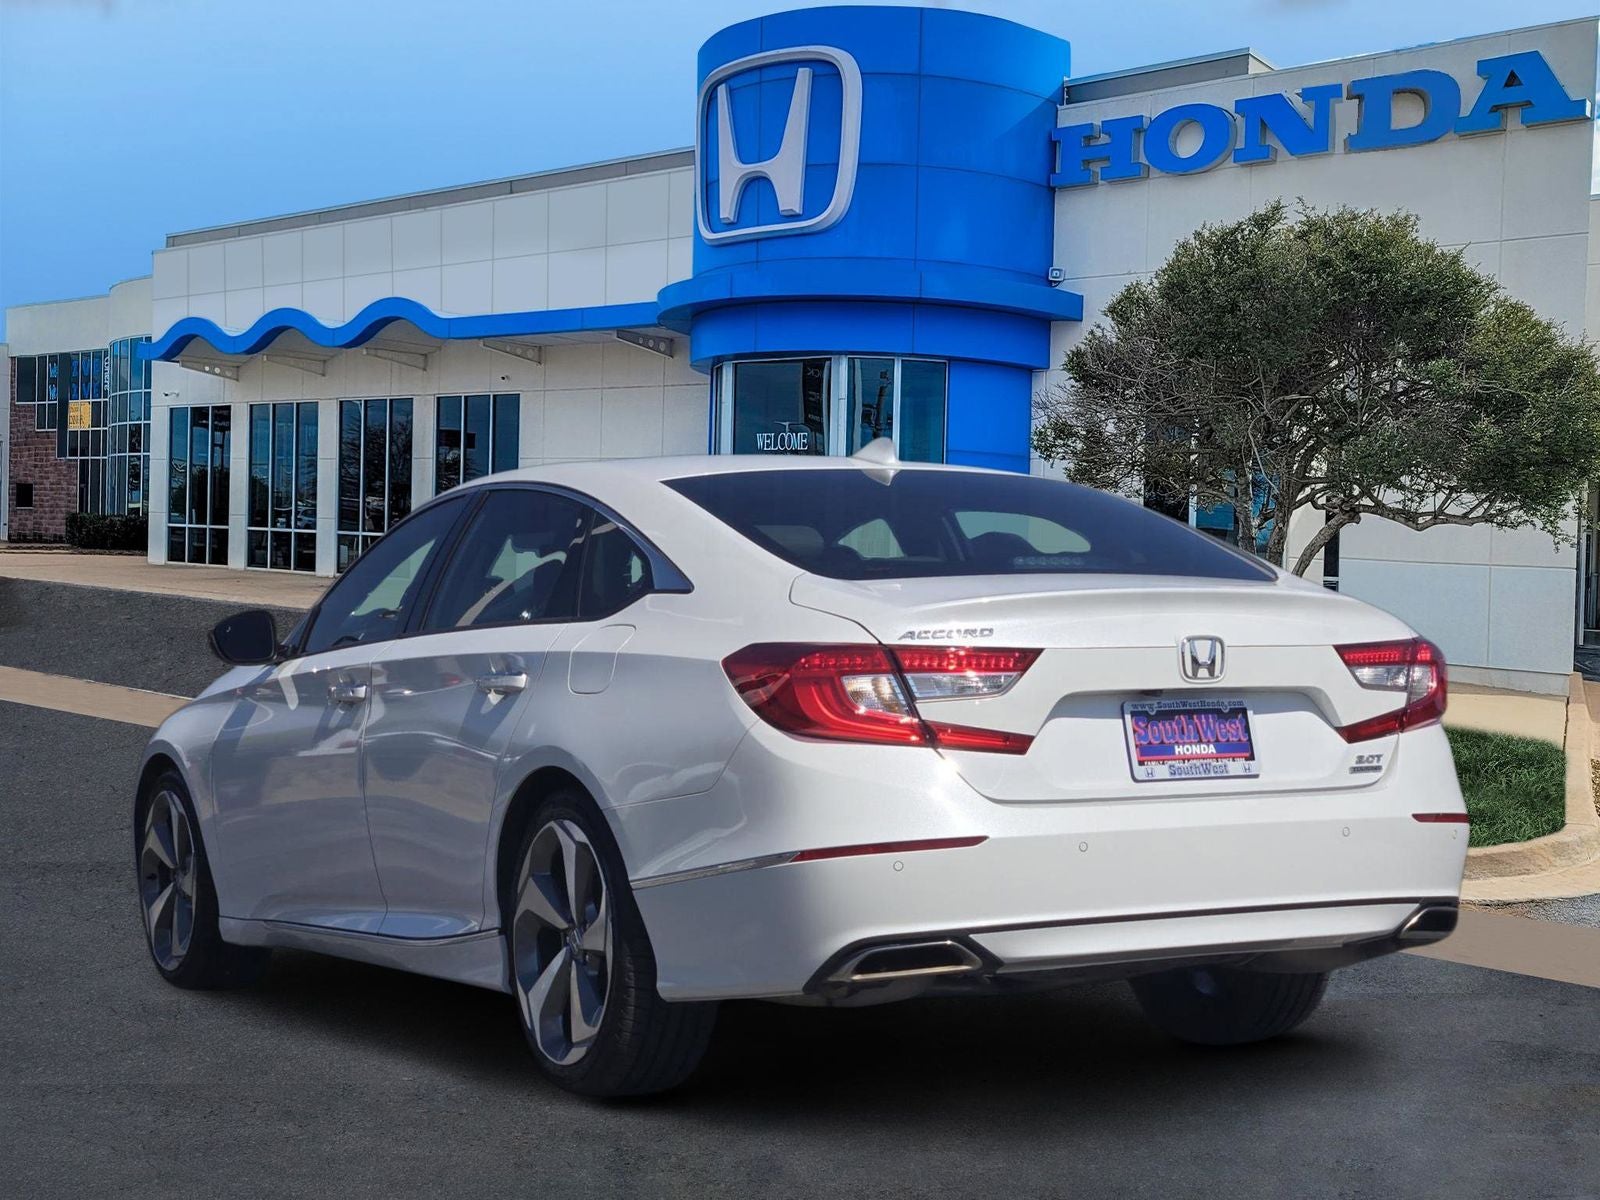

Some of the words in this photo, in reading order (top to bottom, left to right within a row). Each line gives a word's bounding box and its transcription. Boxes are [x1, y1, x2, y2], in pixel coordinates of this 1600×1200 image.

[1050, 49, 1592, 188] HONDA
[756, 432, 809, 451] WELCOME
[897, 627, 994, 641] ACCORD
[1174, 743, 1217, 755] HONDA
